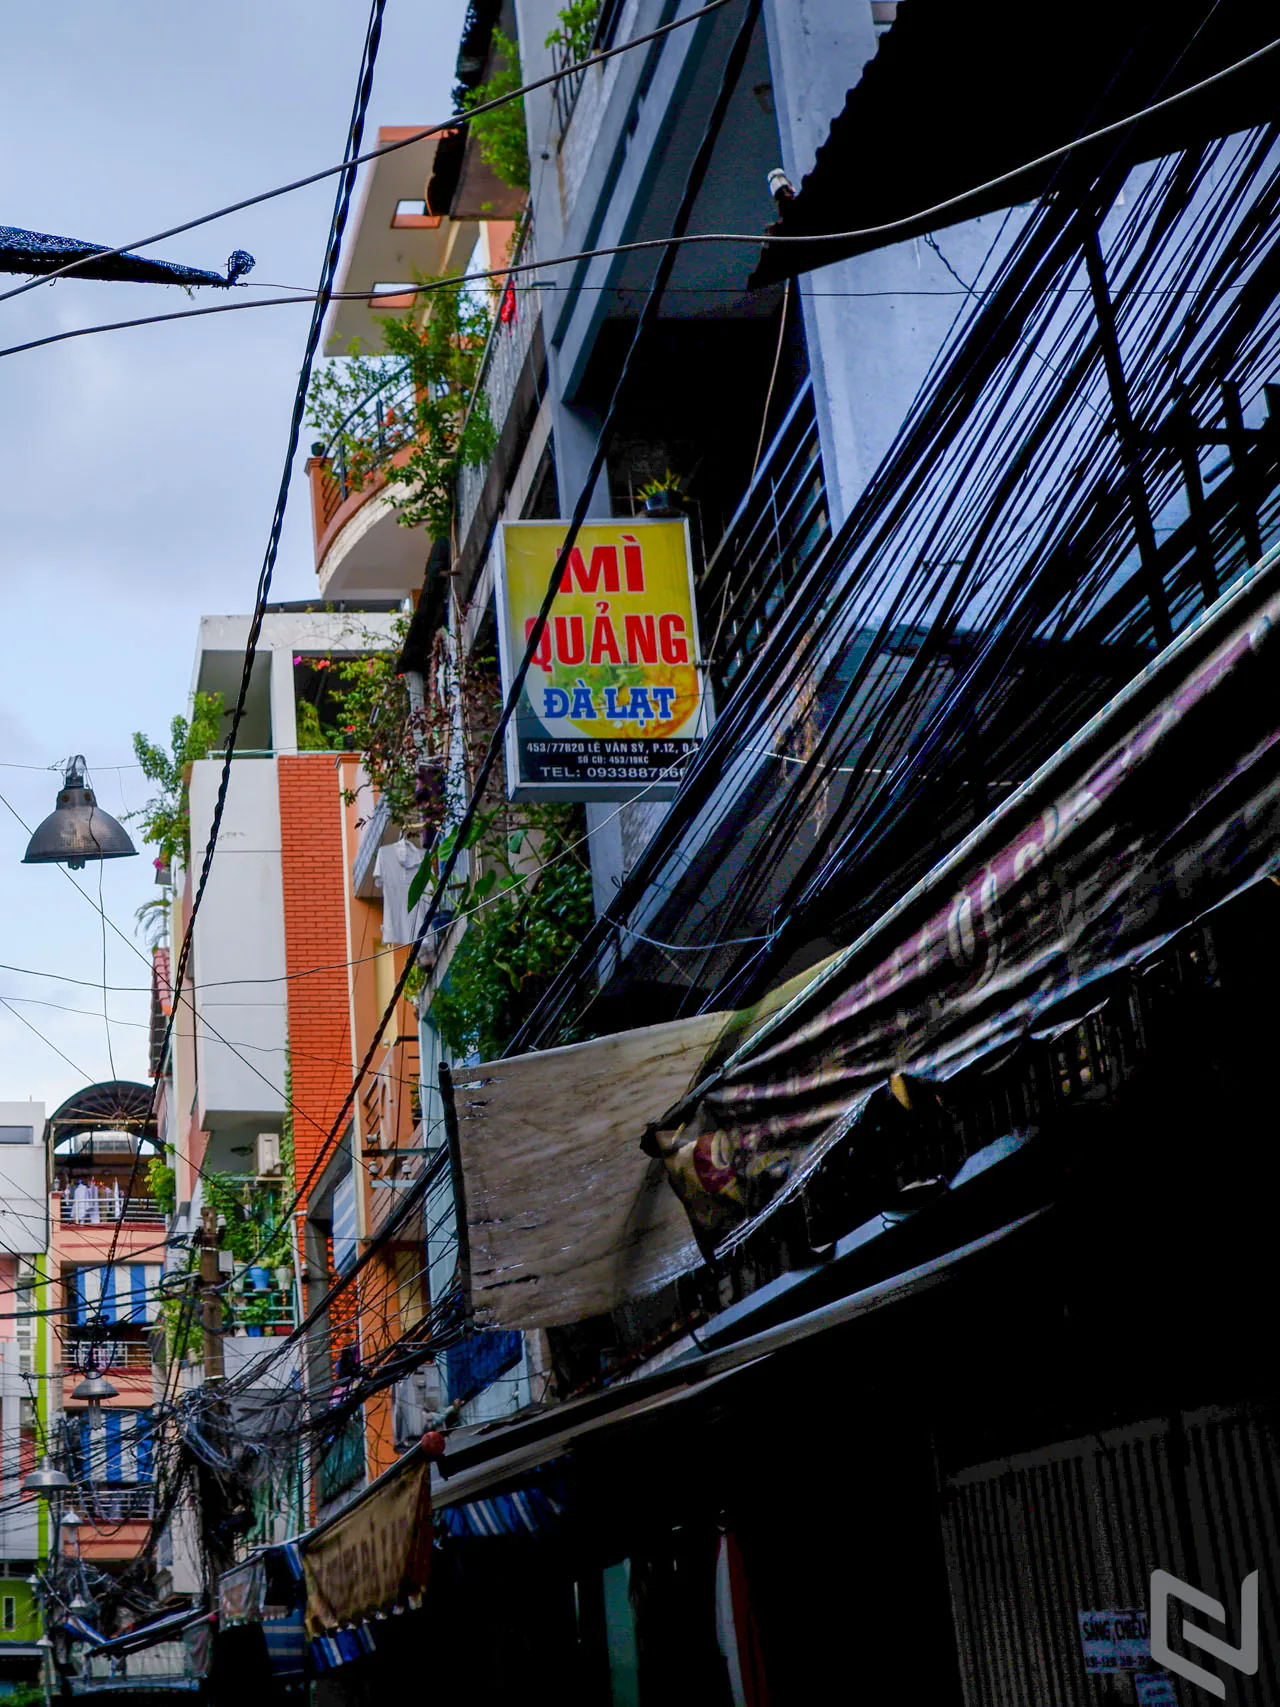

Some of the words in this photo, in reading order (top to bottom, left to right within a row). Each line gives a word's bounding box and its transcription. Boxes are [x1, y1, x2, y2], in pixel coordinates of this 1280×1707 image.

[556, 535, 645, 594] MÌ
[524, 601, 689, 672] QUẢNG
[543, 680, 597, 719] ĐÀ
[604, 687, 675, 726] LẠT
[588, 741, 600, 753] LÊ
[539, 766, 581, 778] TEL:
